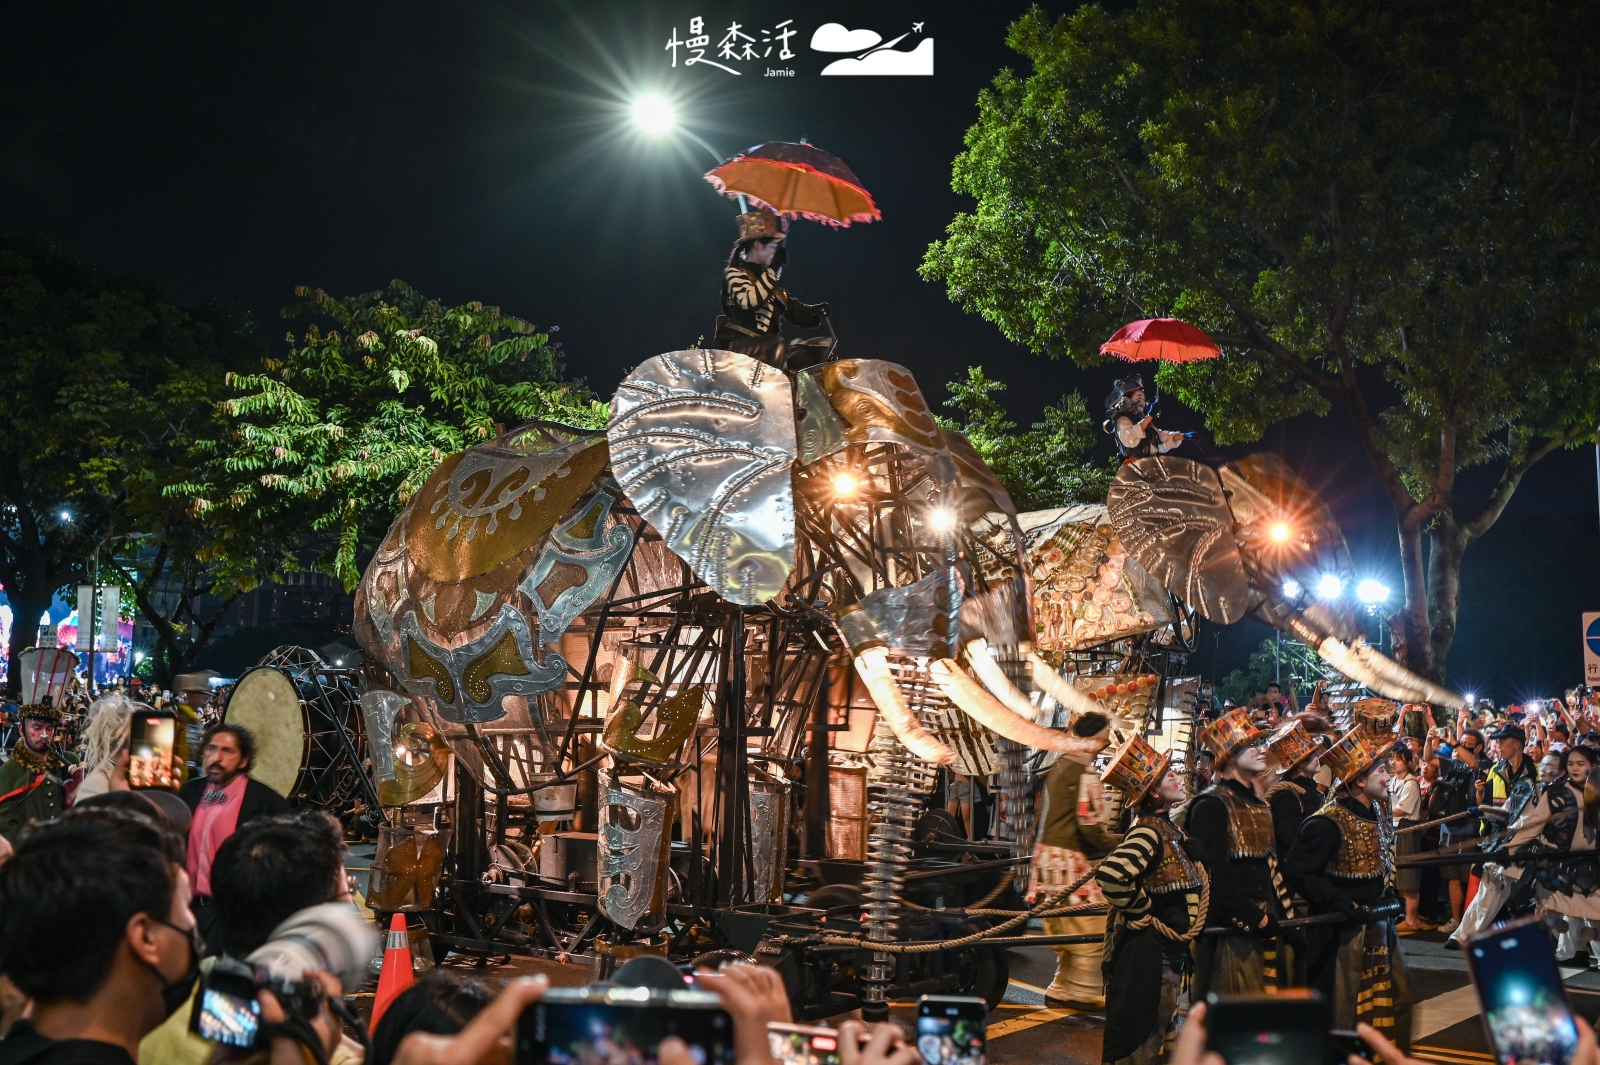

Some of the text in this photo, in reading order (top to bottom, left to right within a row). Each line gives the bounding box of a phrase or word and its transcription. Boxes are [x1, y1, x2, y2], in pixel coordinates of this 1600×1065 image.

[41, 626, 48, 636] P
[1587, 663, 1598, 674] 行
[577, 914, 588, 923] GS
